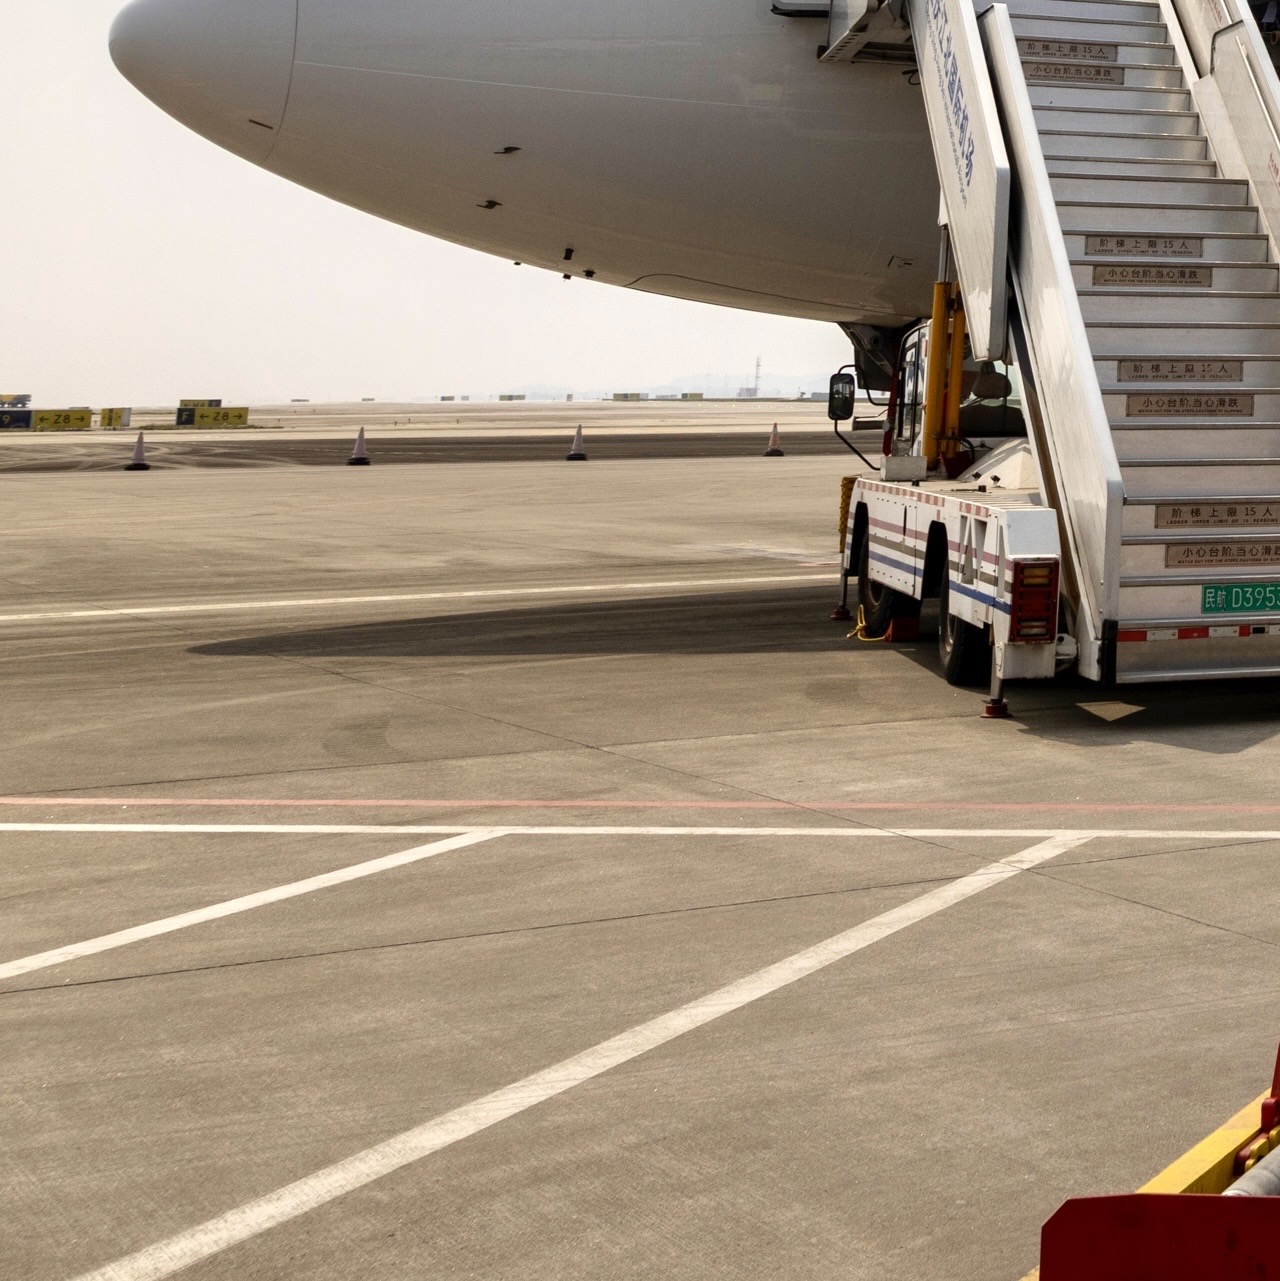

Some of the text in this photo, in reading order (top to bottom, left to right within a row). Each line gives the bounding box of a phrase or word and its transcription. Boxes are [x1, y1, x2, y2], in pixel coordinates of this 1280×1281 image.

[53, 414, 71, 424] Z8
[213, 412, 229, 421] Z8
[1171, 506, 1273, 518] 阶梯上限15人
